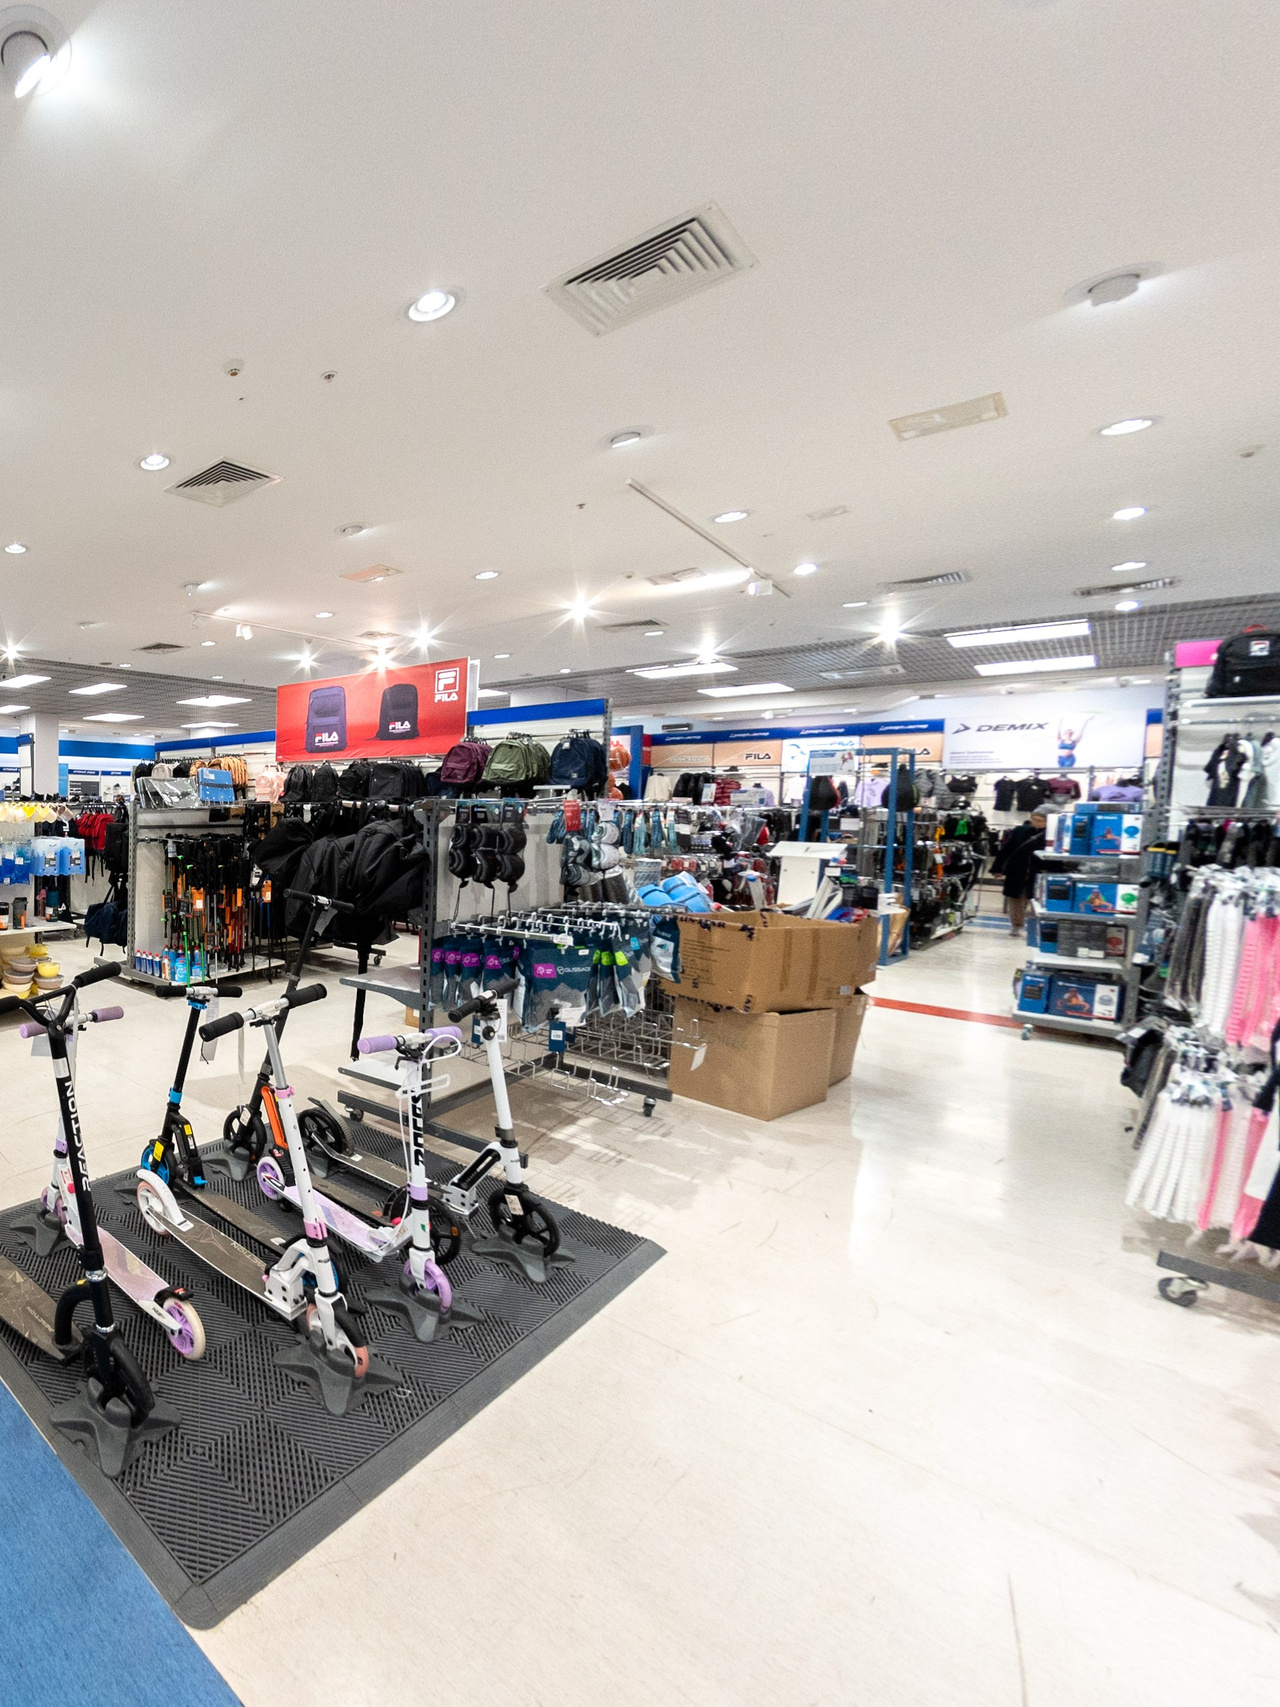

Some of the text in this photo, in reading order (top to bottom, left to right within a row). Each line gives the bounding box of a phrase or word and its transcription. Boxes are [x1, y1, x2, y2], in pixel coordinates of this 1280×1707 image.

[434, 692, 458, 703] FILA
[389, 720, 411, 730] FILA
[976, 723, 1049, 732] DEMIX
[315, 731, 338, 742] FILA
[64, 1081, 91, 1192] REACTION
[230, 1241, 267, 1272] ACTION
